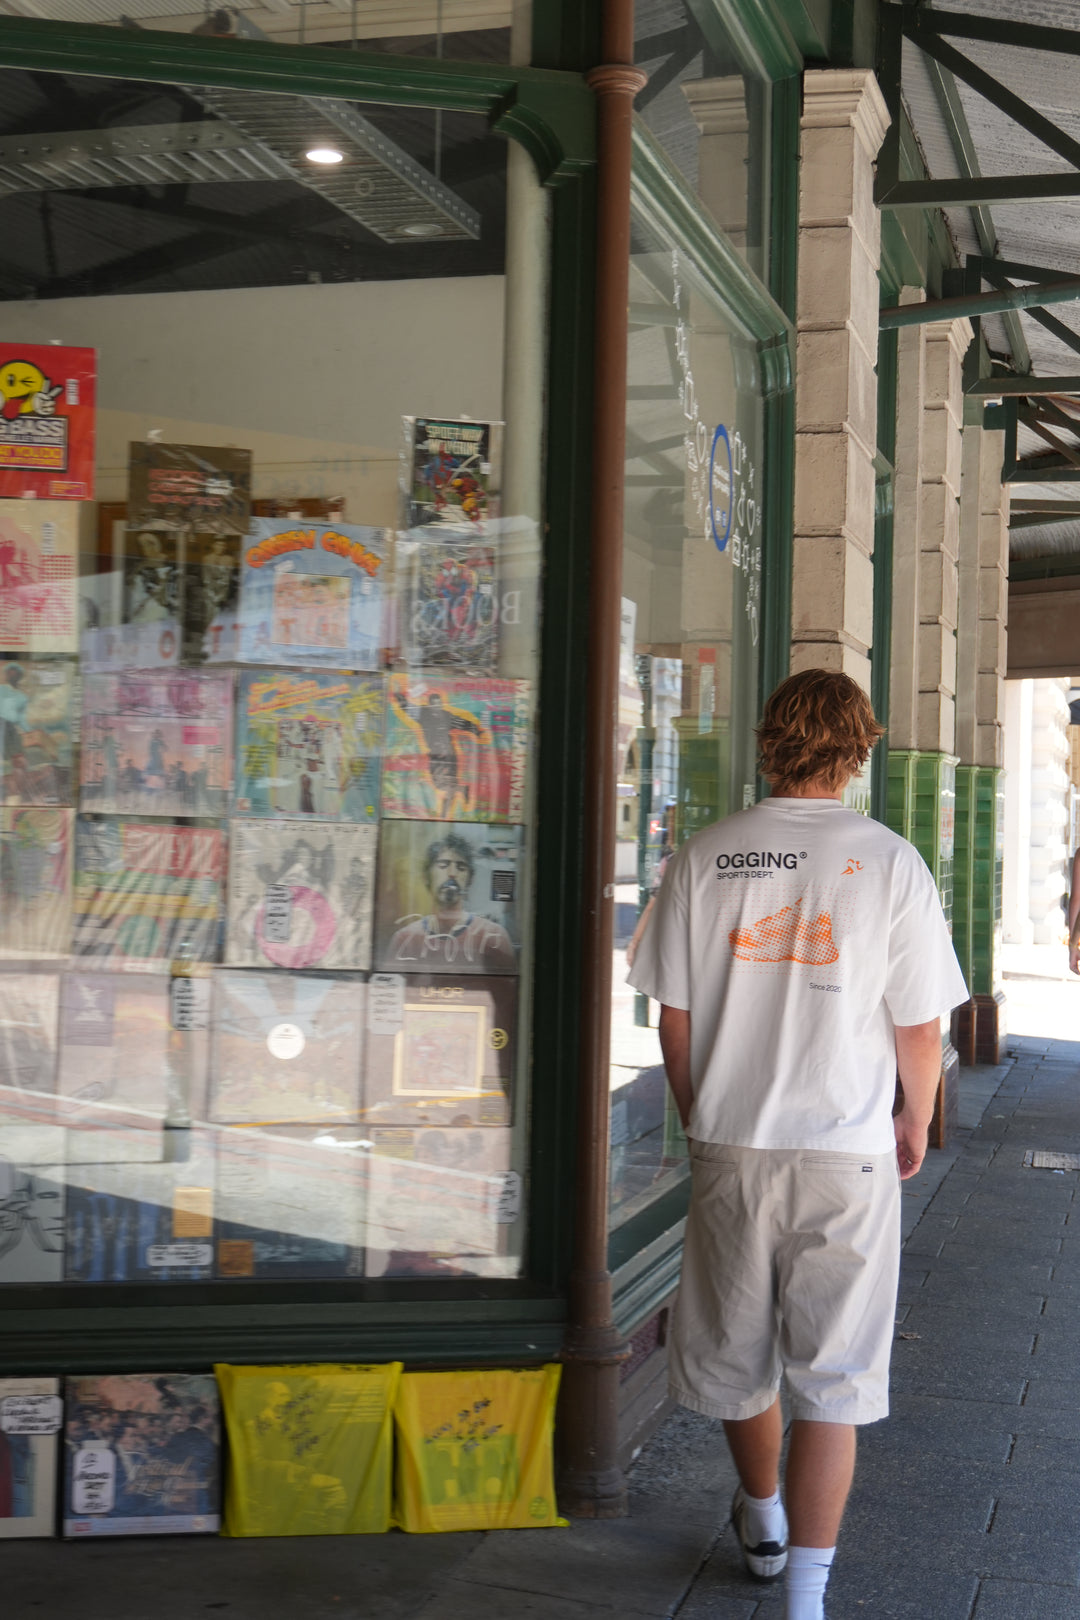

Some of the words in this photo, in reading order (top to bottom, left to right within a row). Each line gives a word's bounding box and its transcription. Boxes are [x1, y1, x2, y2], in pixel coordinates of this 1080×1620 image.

[10, 419, 64, 437] BASS
[717, 871, 750, 880] SPORTS
[751, 870, 774, 879] DEPT.
[809, 982, 825, 991] Since
[825, 984, 842, 993] 2020
